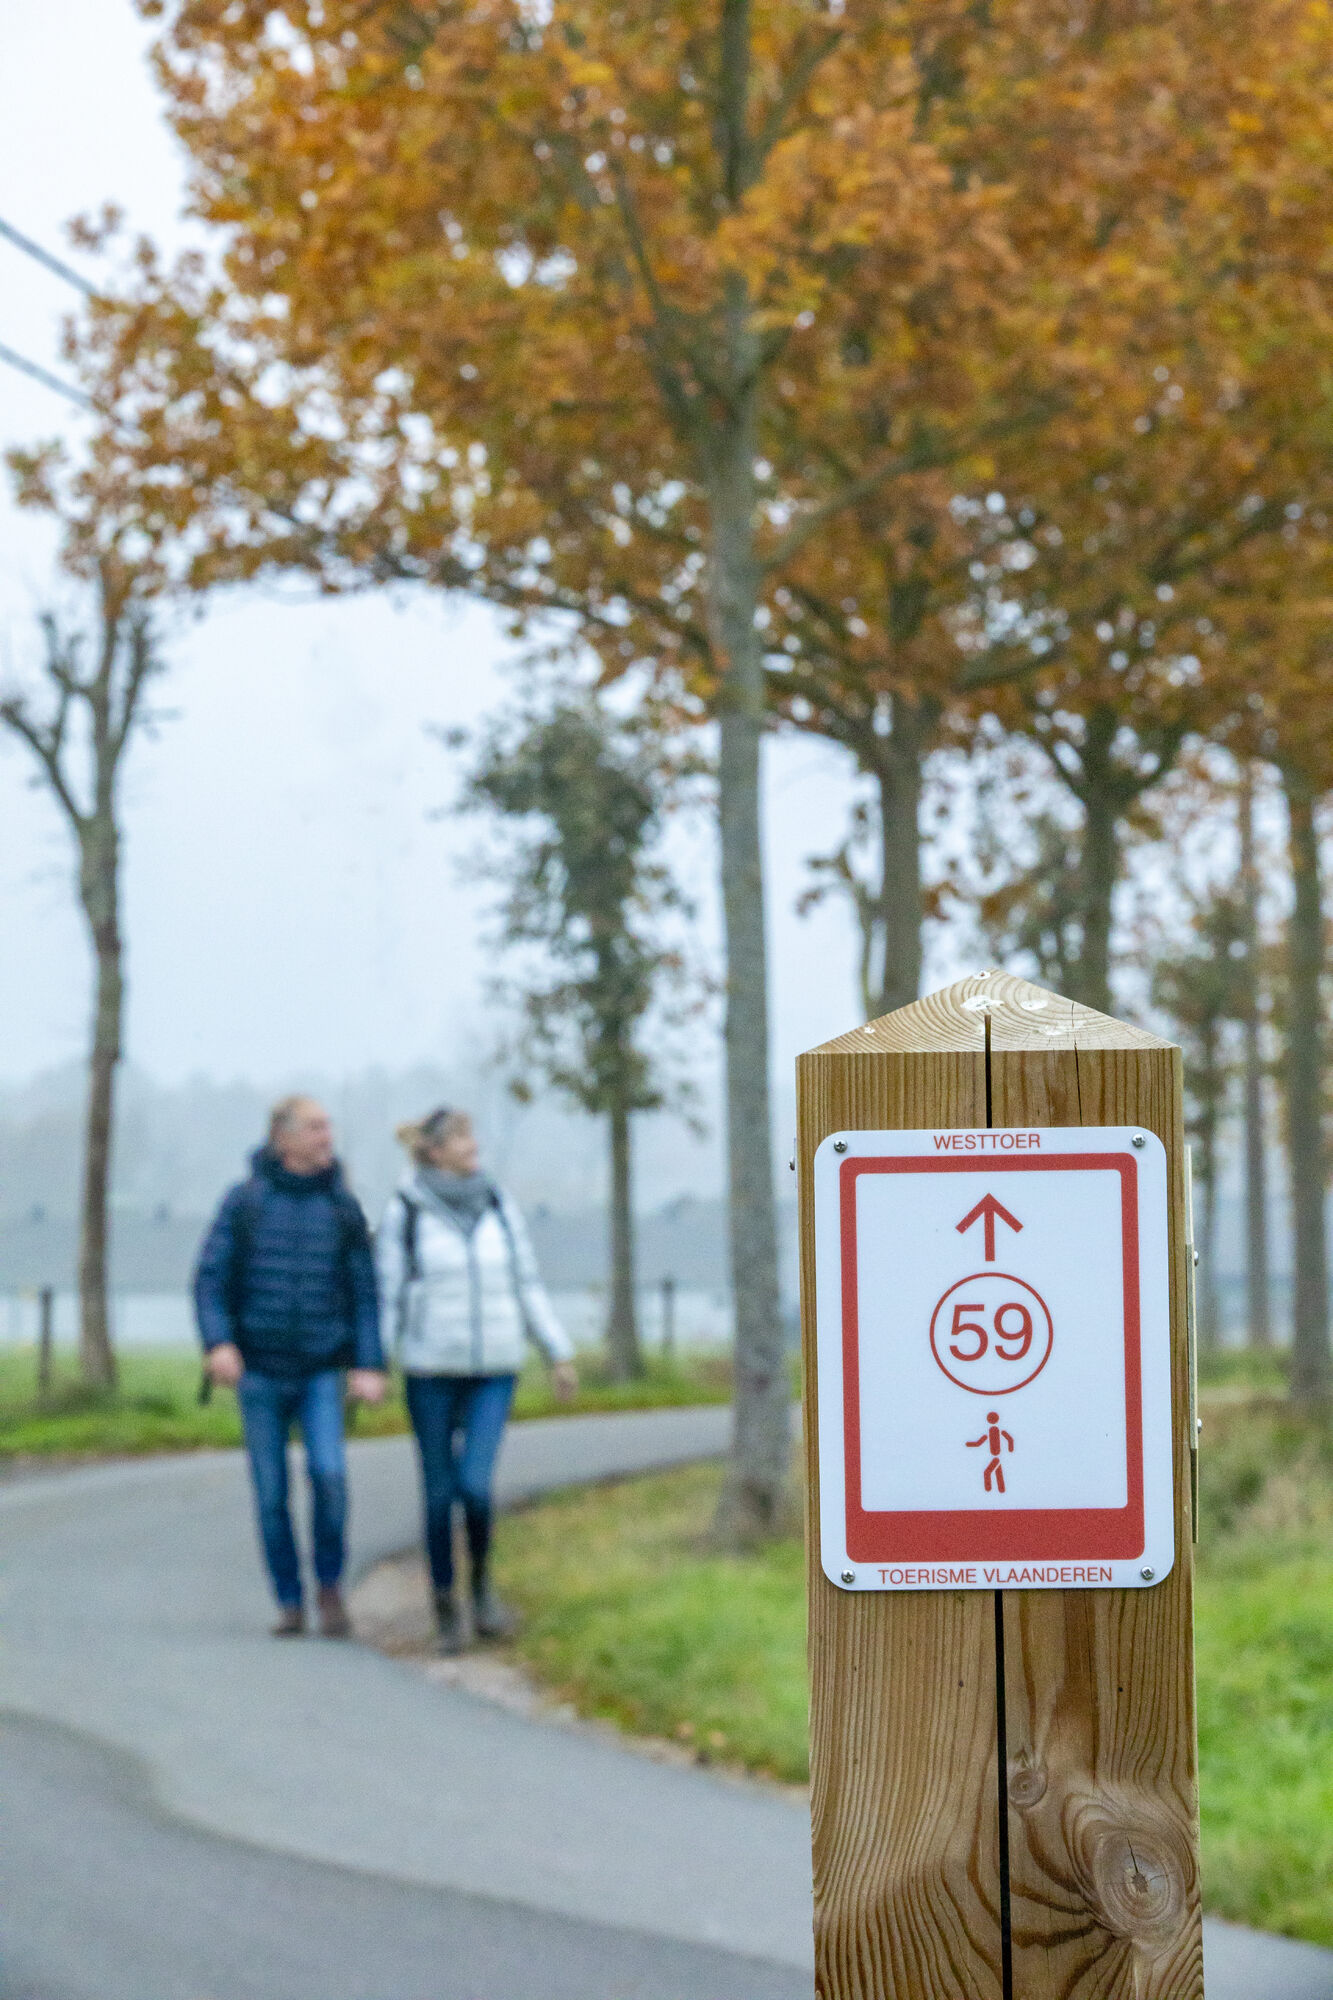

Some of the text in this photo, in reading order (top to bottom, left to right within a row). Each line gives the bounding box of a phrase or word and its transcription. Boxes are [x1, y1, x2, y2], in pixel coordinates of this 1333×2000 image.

[933, 1133, 1041, 1150] WESTTOER
[949, 1302, 1033, 1362] 59
[878, 1566, 1113, 1585] TOERISME VLAANDEREN
